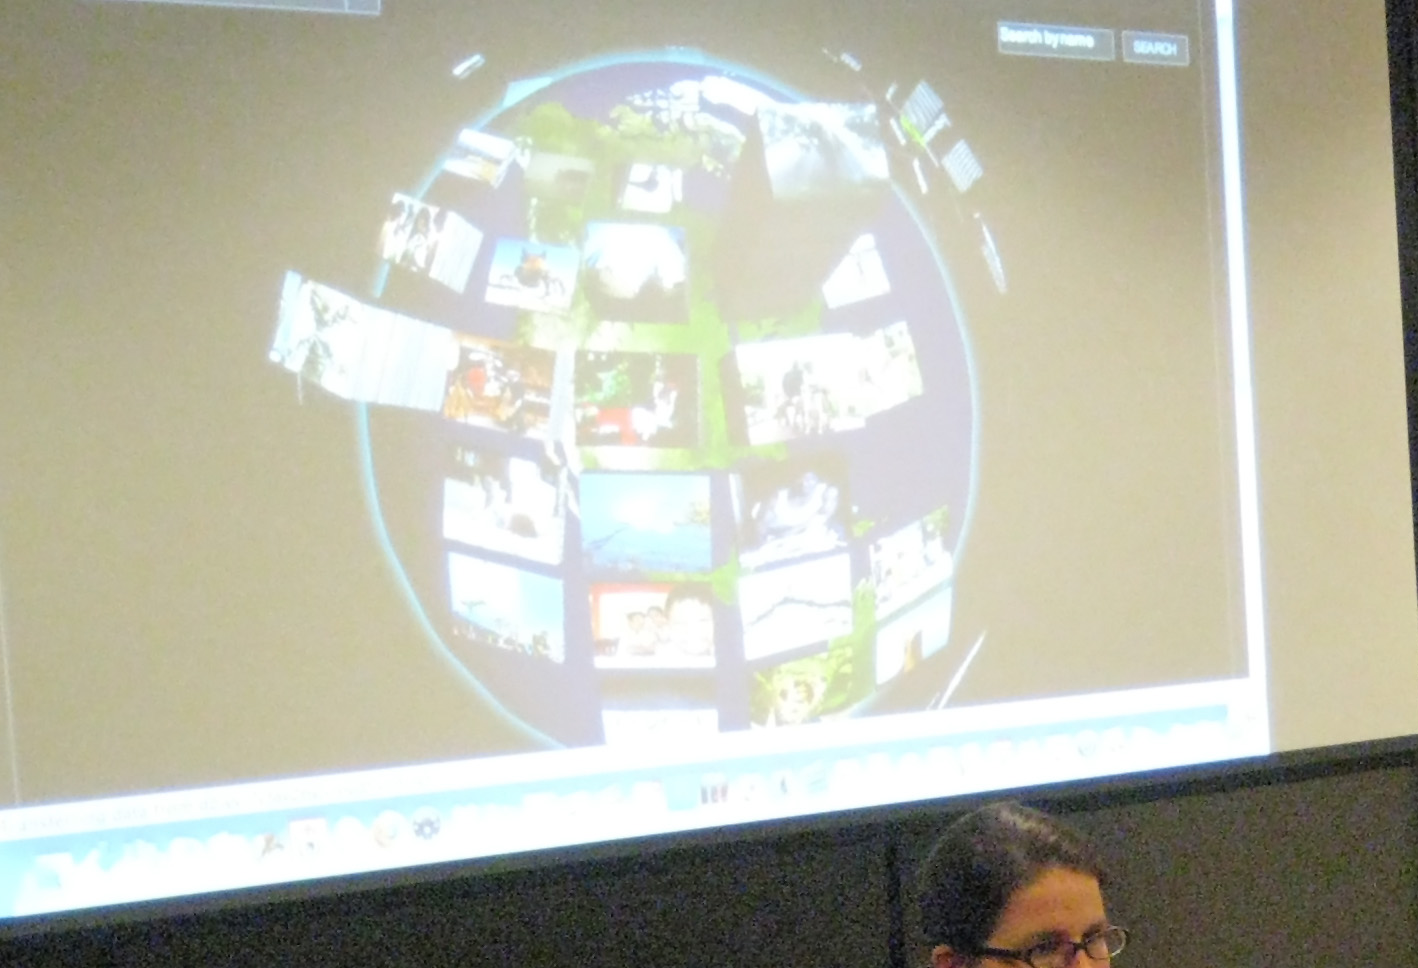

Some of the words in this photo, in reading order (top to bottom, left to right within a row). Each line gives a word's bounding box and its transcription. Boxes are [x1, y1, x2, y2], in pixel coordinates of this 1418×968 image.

[1000, 26, 1043, 44] Search
[1044, 30, 1058, 49] by
[1059, 33, 1095, 48] name
[1133, 39, 1178, 56] SEARCH
